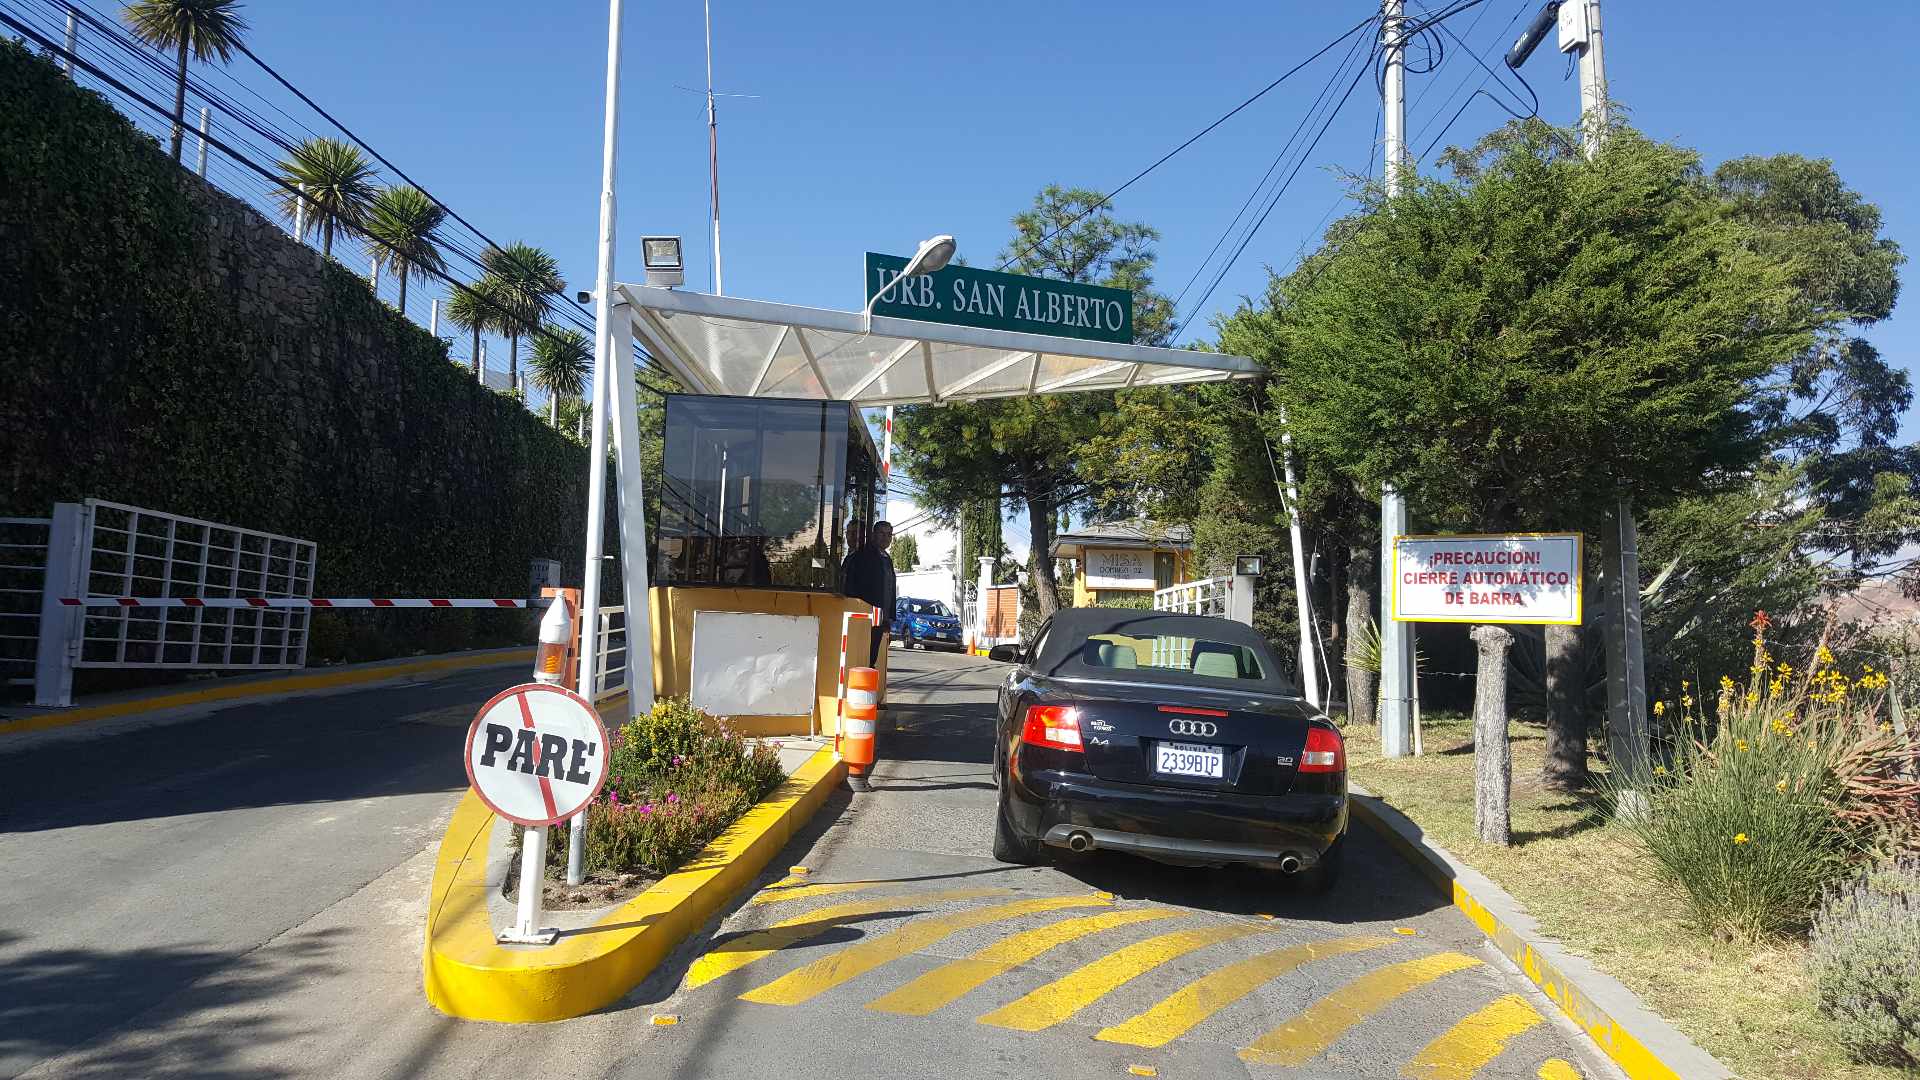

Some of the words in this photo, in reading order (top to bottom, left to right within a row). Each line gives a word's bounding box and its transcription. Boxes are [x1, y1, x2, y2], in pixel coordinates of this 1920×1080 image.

[877, 268, 942, 310] URB.
[953, 278, 1006, 318] SAN
[1015, 287, 1124, 332] ALBERTO
[1102, 553, 1144, 567] MISA
[1404, 572, 1457, 585] CIERRE
[1463, 569, 1569, 586] AUTOMÁTICO
[1445, 592, 1464, 605] DE
[1470, 592, 1522, 605] BARRA
[1162, 751, 1219, 774] 2339BIP
